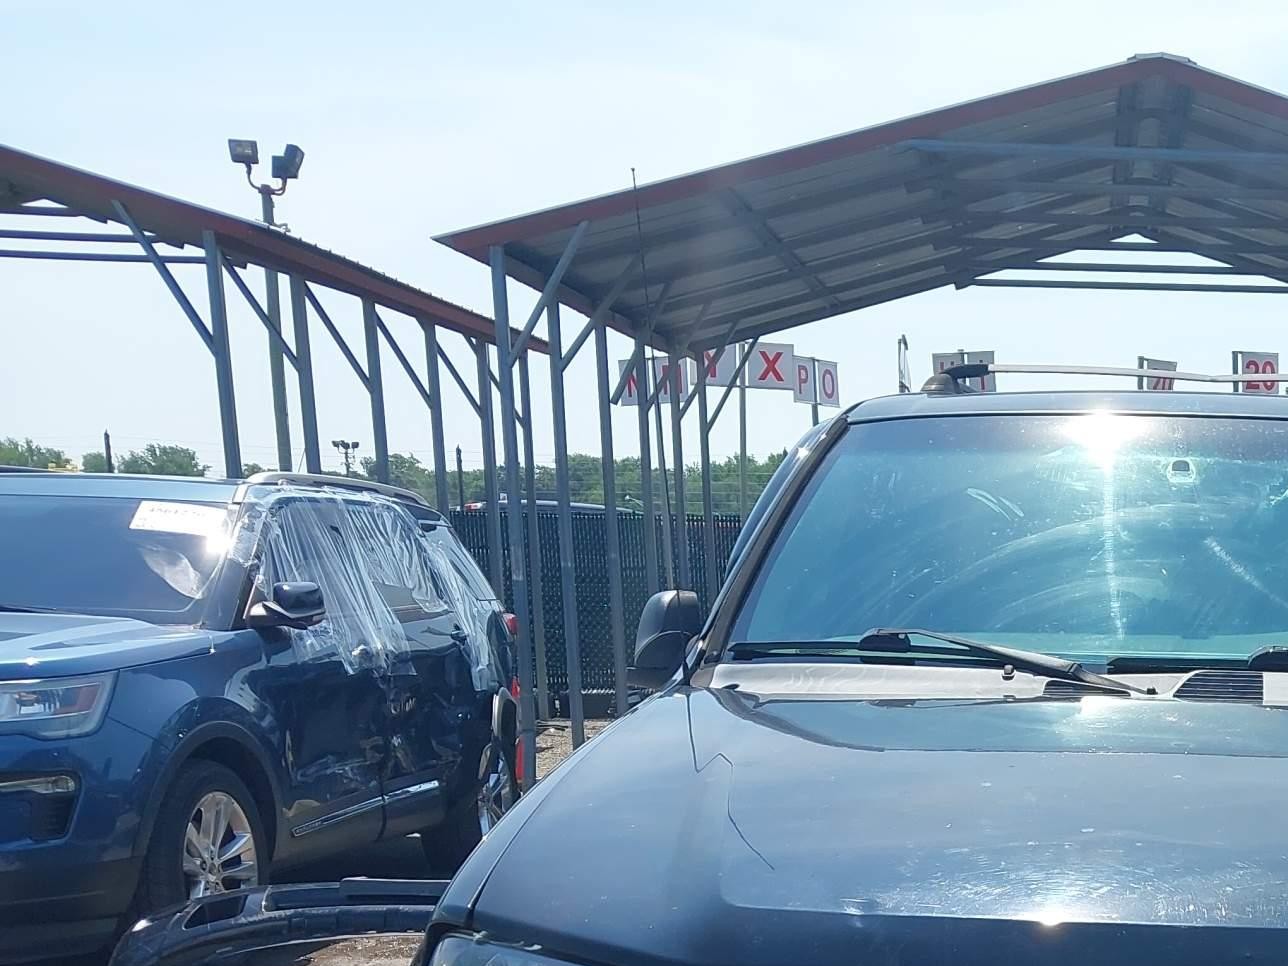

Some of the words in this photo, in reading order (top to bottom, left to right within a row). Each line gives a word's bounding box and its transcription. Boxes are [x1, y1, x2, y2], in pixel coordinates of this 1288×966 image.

[758, 350, 784, 382] X
[798, 364, 808, 395] P
[1245, 360, 1276, 391] 20
[822, 368, 835, 399] O
